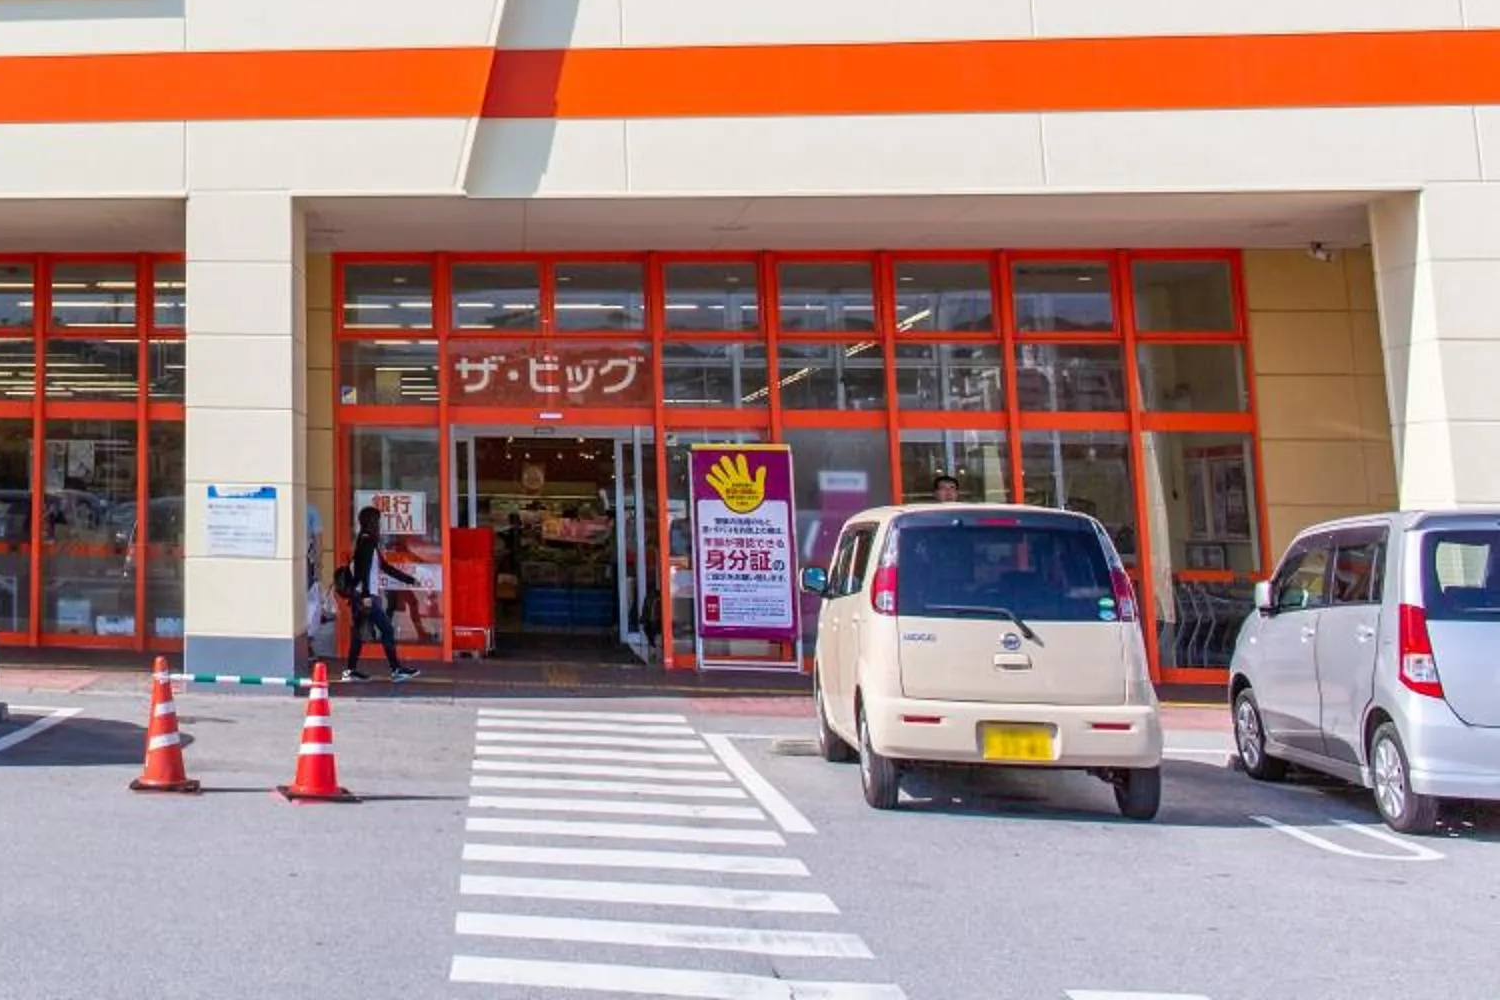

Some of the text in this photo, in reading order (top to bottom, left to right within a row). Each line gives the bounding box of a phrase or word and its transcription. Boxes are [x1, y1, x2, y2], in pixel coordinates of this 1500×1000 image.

[455, 355, 645, 393] ザ・ビッグ
[383, 513, 414, 531] TM
[705, 549, 785, 571] 身分証の
